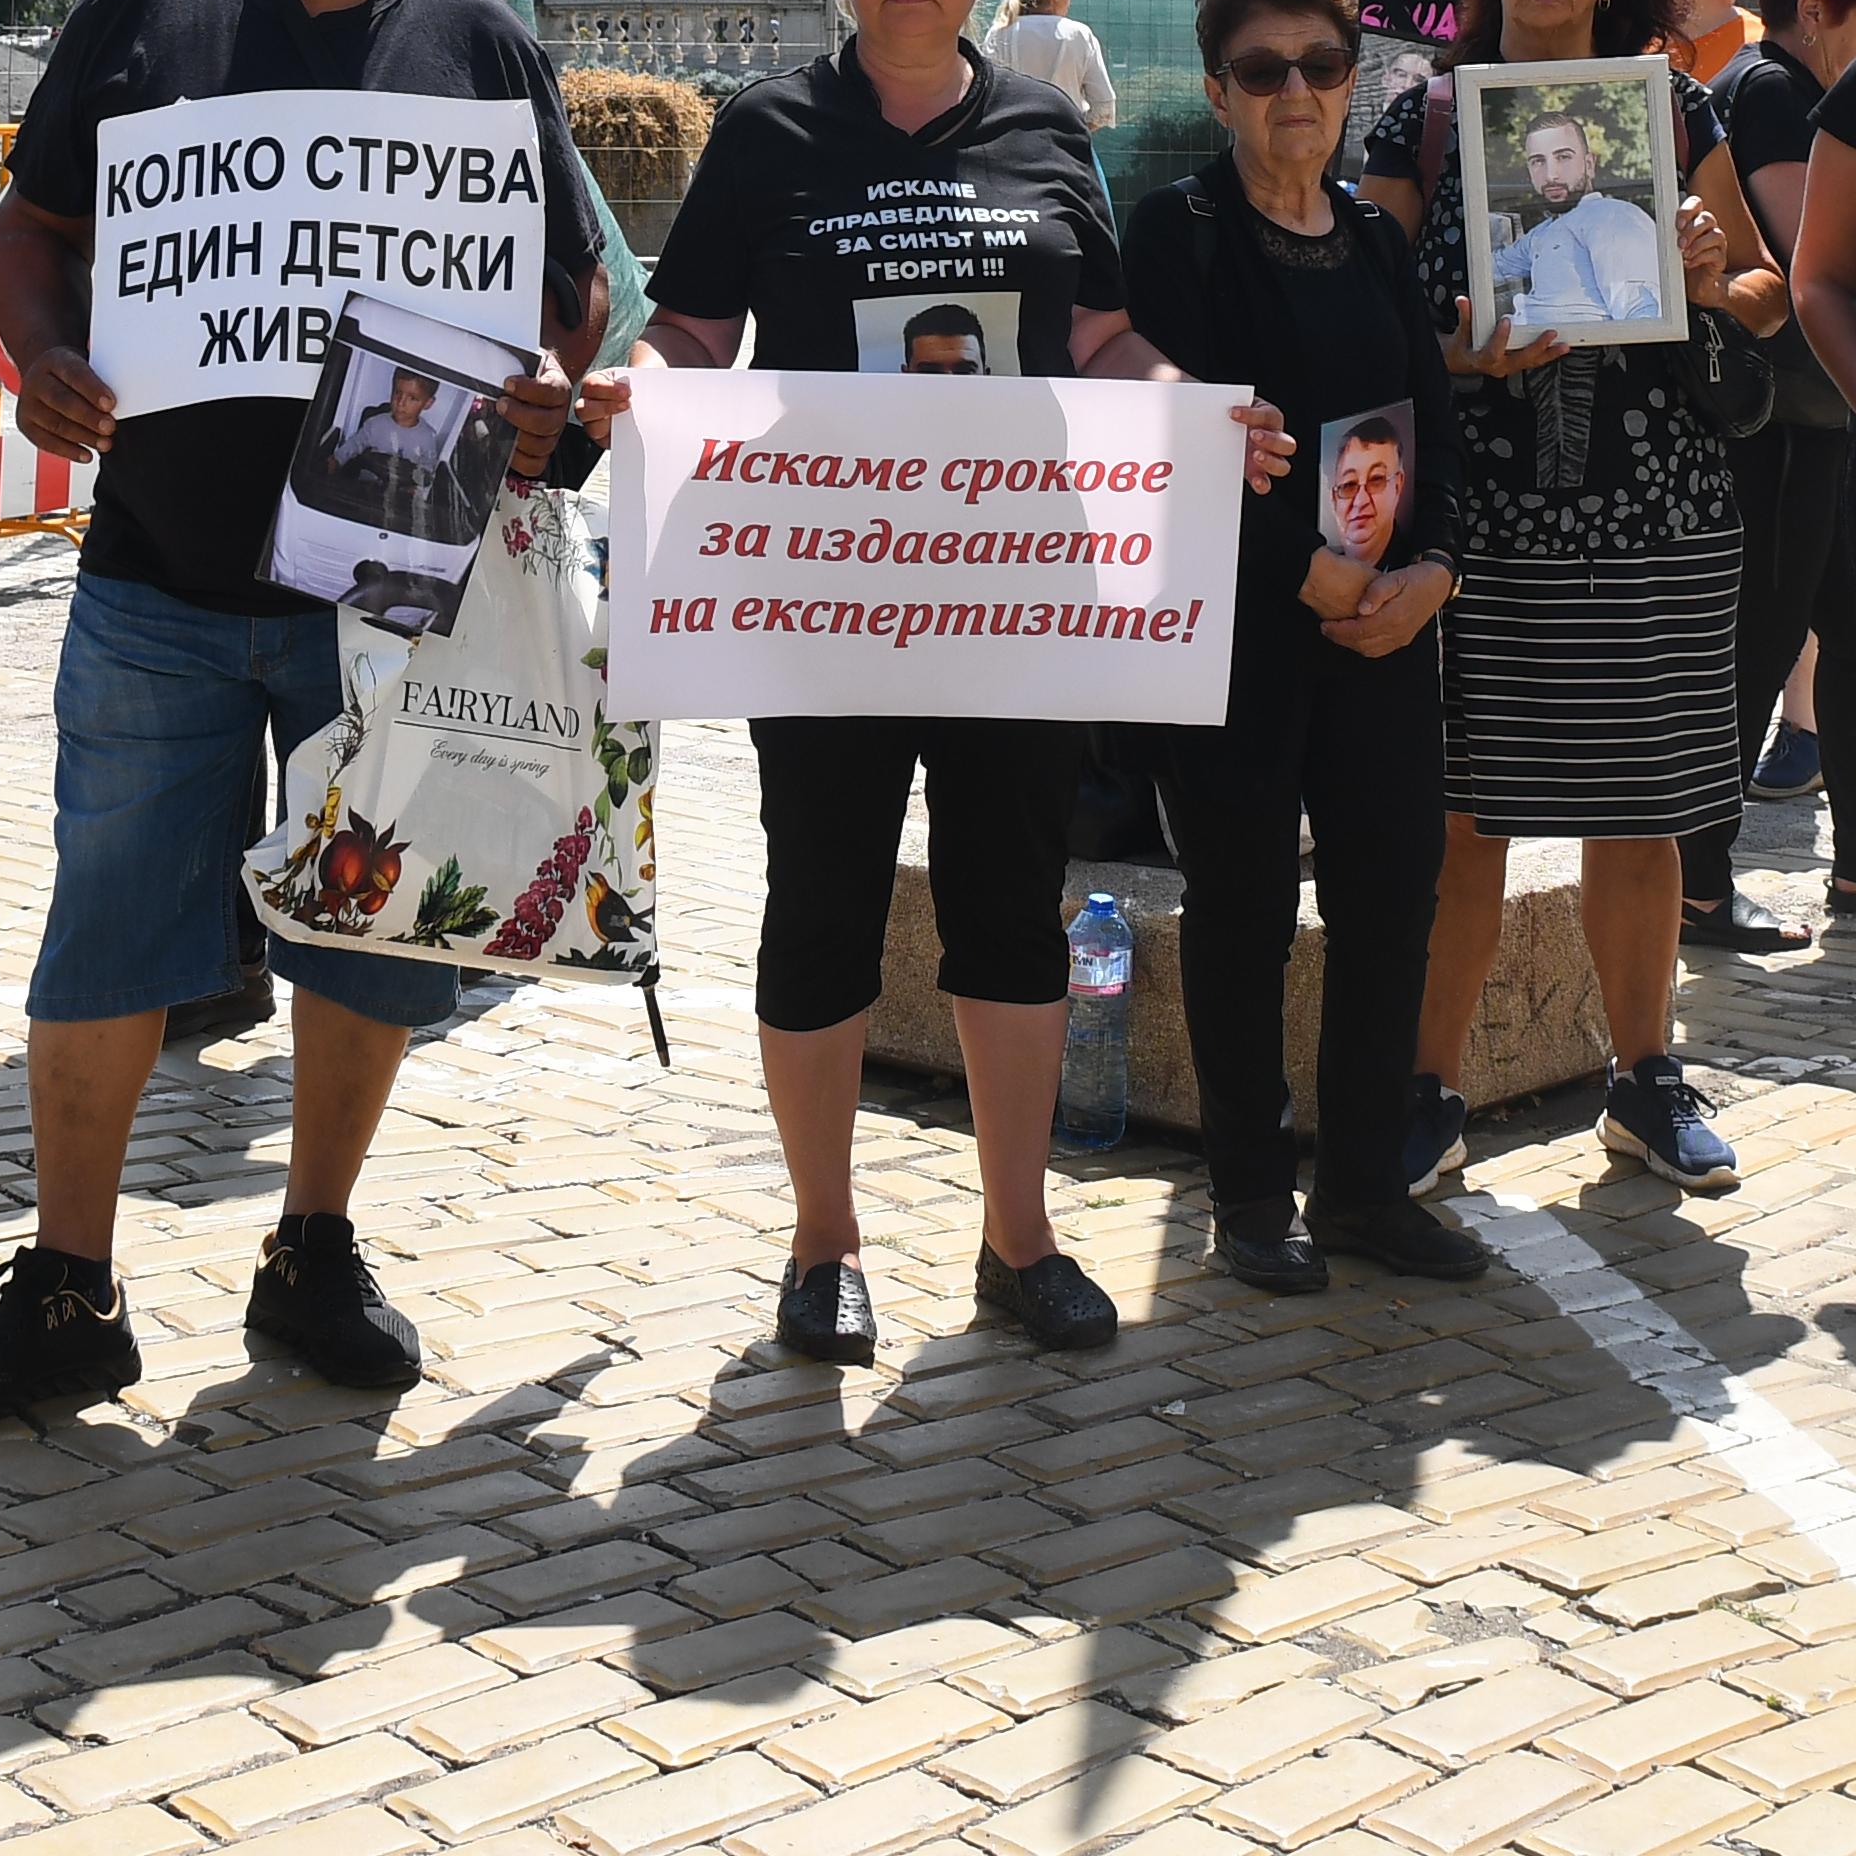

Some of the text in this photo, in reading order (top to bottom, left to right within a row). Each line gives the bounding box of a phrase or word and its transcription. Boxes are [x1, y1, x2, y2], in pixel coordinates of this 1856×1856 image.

[107, 135, 539, 217] КОЛКО СТРУВА
[867, 180, 977, 201] ИСКАМЕ
[809, 206, 1040, 236] СПРАВЕДЛИВОСТ
[836, 230, 1027, 255] ЗА СИНЪТ МИ
[118, 220, 514, 303] ЕДИН ДЕТСКИ
[867, 258, 1005, 282] ГЕОРГИ !!!
[198, 306, 332, 367] ЖИВ
[691, 439, 1173, 505] Искаме срокове
[699, 518, 1152, 567] за издаването
[649, 597, 1204, 649] на експертизите!
[430, 738, 550, 778] Every day is spring
